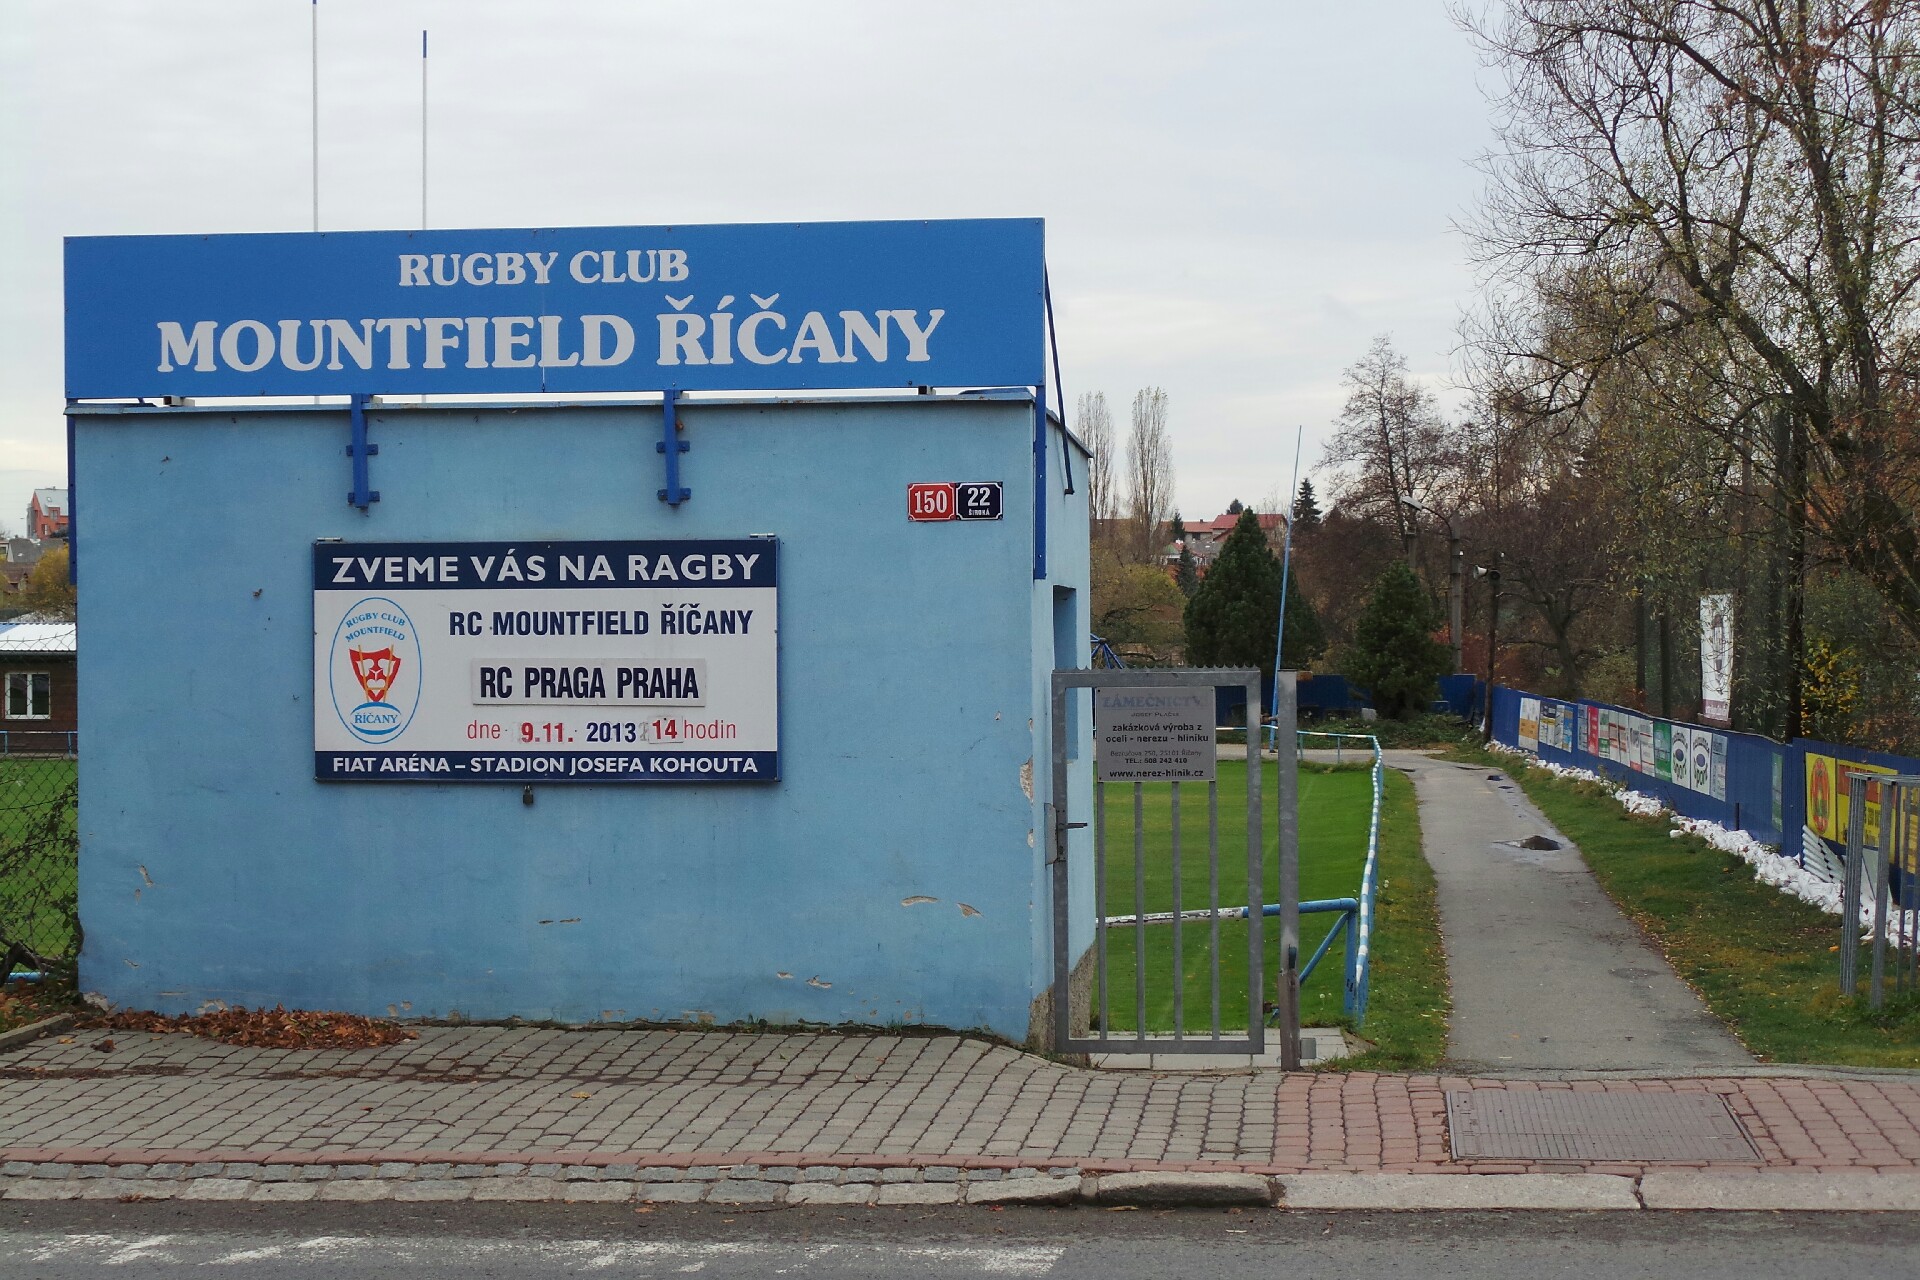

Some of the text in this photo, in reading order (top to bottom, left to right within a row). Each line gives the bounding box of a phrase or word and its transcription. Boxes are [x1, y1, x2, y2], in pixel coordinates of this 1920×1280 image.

[399, 249, 690, 286] RUGBY CLUB
[157, 293, 945, 373] MOUNTFIELD ŘÍČANY
[915, 490, 947, 514] 150
[967, 487, 991, 507] 22
[332, 548, 760, 583] ZVEME VÁS NA RAGBY
[345, 612, 406, 629] RUGBY CLUB
[449, 603, 754, 636] RC MOUNTFIELD ŘÍČANY
[345, 626, 405, 642] MOUNTFIELD
[480, 666, 699, 698] RC PRAGA PRAHA
[354, 712, 399, 724] ŘÍČANY
[1112, 723, 1160, 732] zakázková
[1163, 723, 1194, 733] výroba
[467, 719, 736, 743] dne 9.11. 2013 14 hodin
[1105, 734, 1128, 743] oceli
[1136, 735, 1168, 743] nerezu
[333, 757, 376, 772] FIAT
[380, 753, 450, 773] ARÉNA
[470, 757, 565, 773] STADION
[569, 757, 645, 776] JOSEFA
[650, 757, 758, 773] KOHOUTA
[1109, 769, 1204, 778] www.nerez-hlinik.cz
